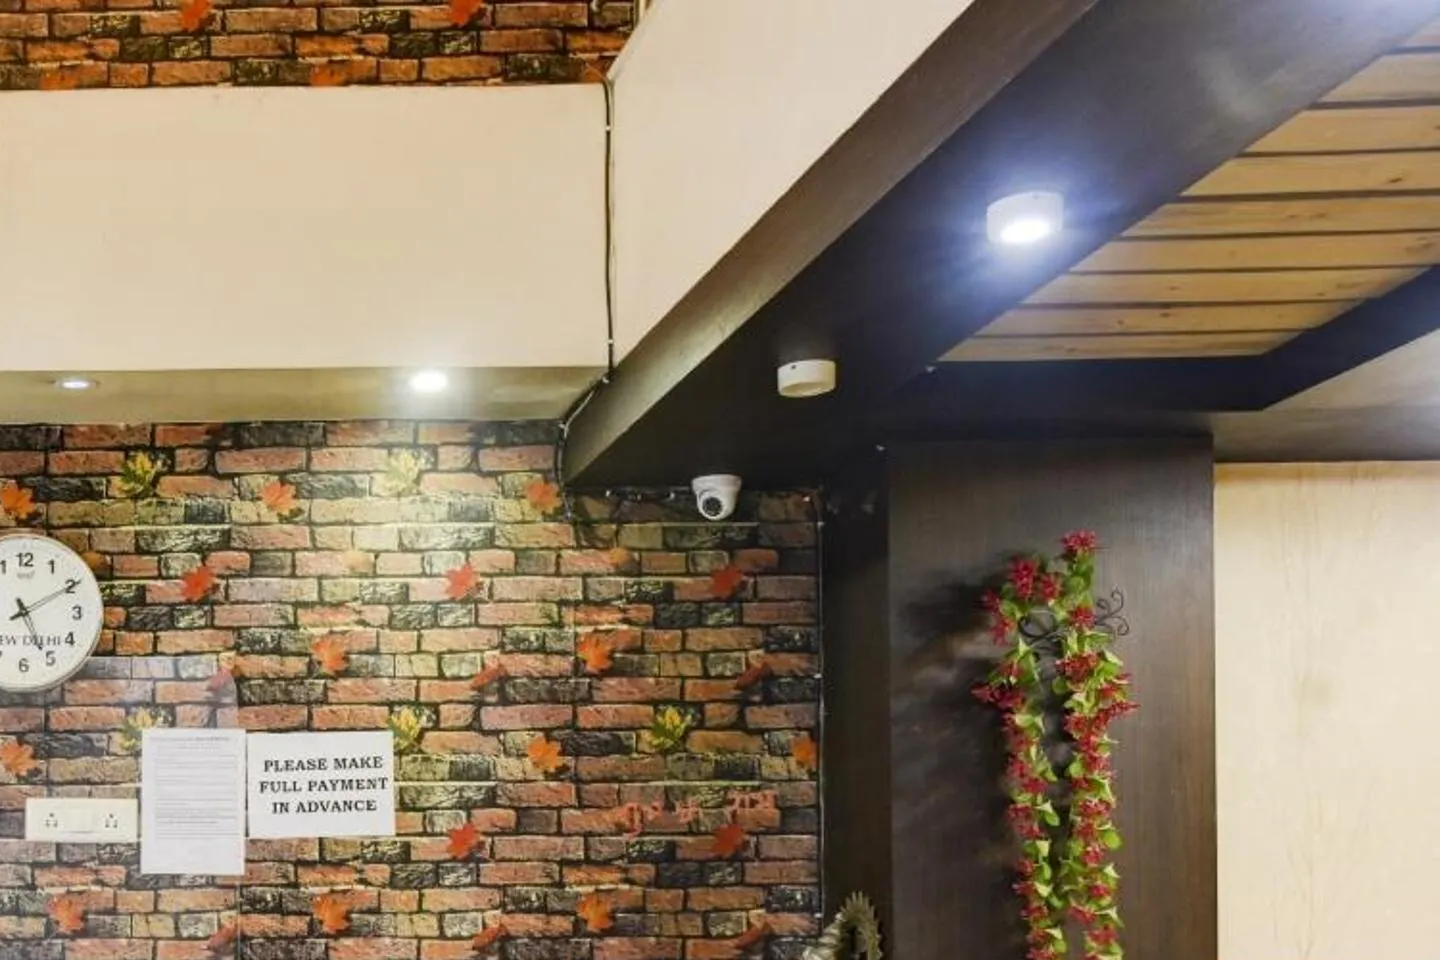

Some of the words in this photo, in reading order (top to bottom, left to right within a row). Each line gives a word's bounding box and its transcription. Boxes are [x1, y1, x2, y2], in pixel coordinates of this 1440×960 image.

[16, 552, 34, 567] 12
[48, 559, 55, 574] 1
[65, 579, 76, 594] 2
[72, 605, 82, 620] 3
[65, 631, 76, 646] 4
[18, 658, 29, 673] 6
[45, 650, 56, 666] 5
[263, 759, 328, 773] PLEASE
[334, 756, 384, 771] MAKE
[259, 779, 303, 794] FULL
[308, 776, 390, 792] PAYMENT
[272, 801, 290, 814] IN
[295, 799, 378, 814] ADVANCE
